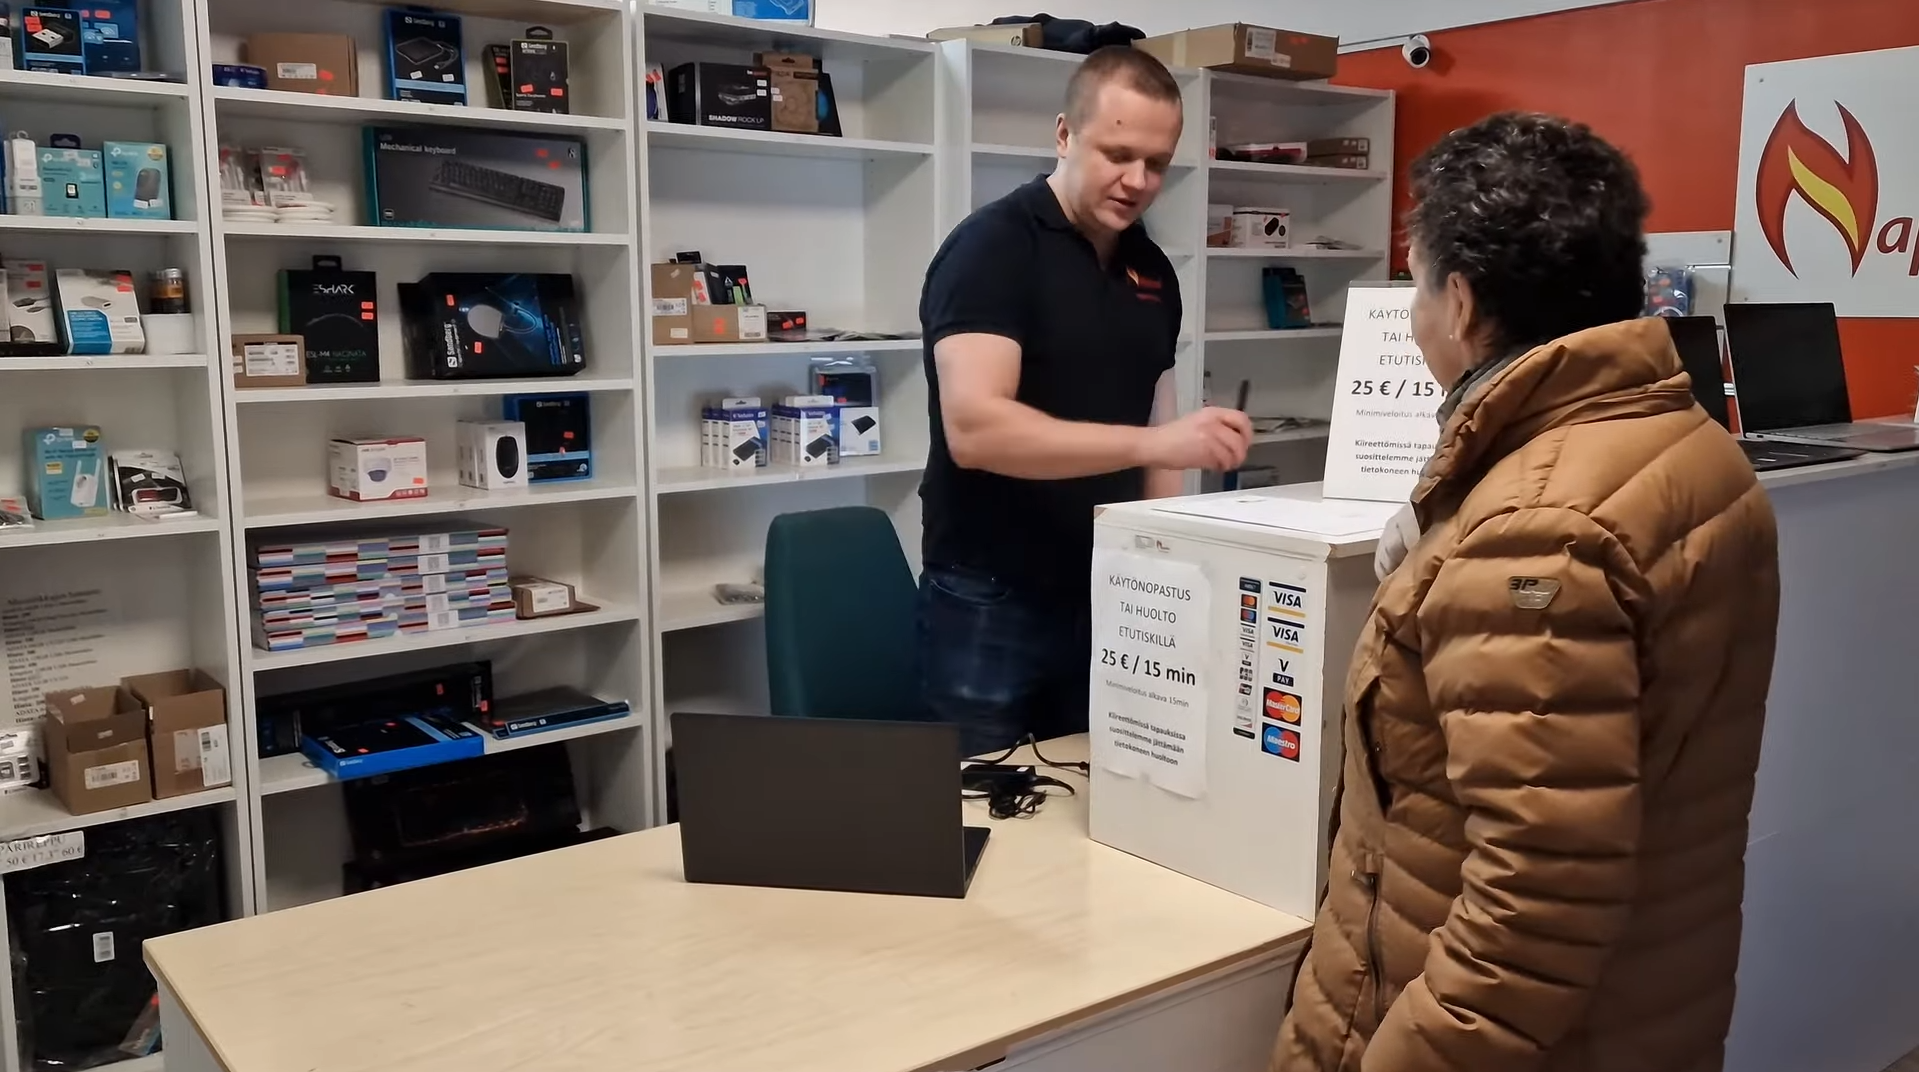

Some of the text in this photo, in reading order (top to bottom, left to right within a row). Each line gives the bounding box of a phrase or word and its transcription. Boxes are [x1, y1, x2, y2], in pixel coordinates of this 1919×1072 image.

[708, 114, 737, 122] SHADOW
[380, 142, 456, 155] Mechanical keyboard
[1382, 332, 1402, 342] TAI
[1351, 380, 1374, 395] 25
[1380, 380, 1391, 396] €
[1395, 379, 1407, 399] /
[1412, 381, 1434, 397] 15
[1355, 453, 1414, 462] suosittelemme
[1360, 465, 1410, 475] tietokoneen
[1273, 590, 1302, 608] VISA
[1120, 601, 1177, 624] TAI HUOLTO
[1119, 625, 1176, 649] ETUTISKILLÄ
[1242, 626, 1254, 635] VISA
[1272, 624, 1299, 643] VISA
[1101, 648, 1196, 686] 25 € / 15 min
[1277, 657, 1290, 672] V
[1277, 675, 1290, 684] PAY
[1169, 696, 1189, 708] 15min
[1267, 699, 1300, 715] MasterCard
[1109, 726, 1152, 744] suosittelemme
[1150, 724, 1186, 741] tapauksissa
[1267, 734, 1296, 749] Maestro
[1114, 740, 1178, 766] tietokoneen huoltoon
